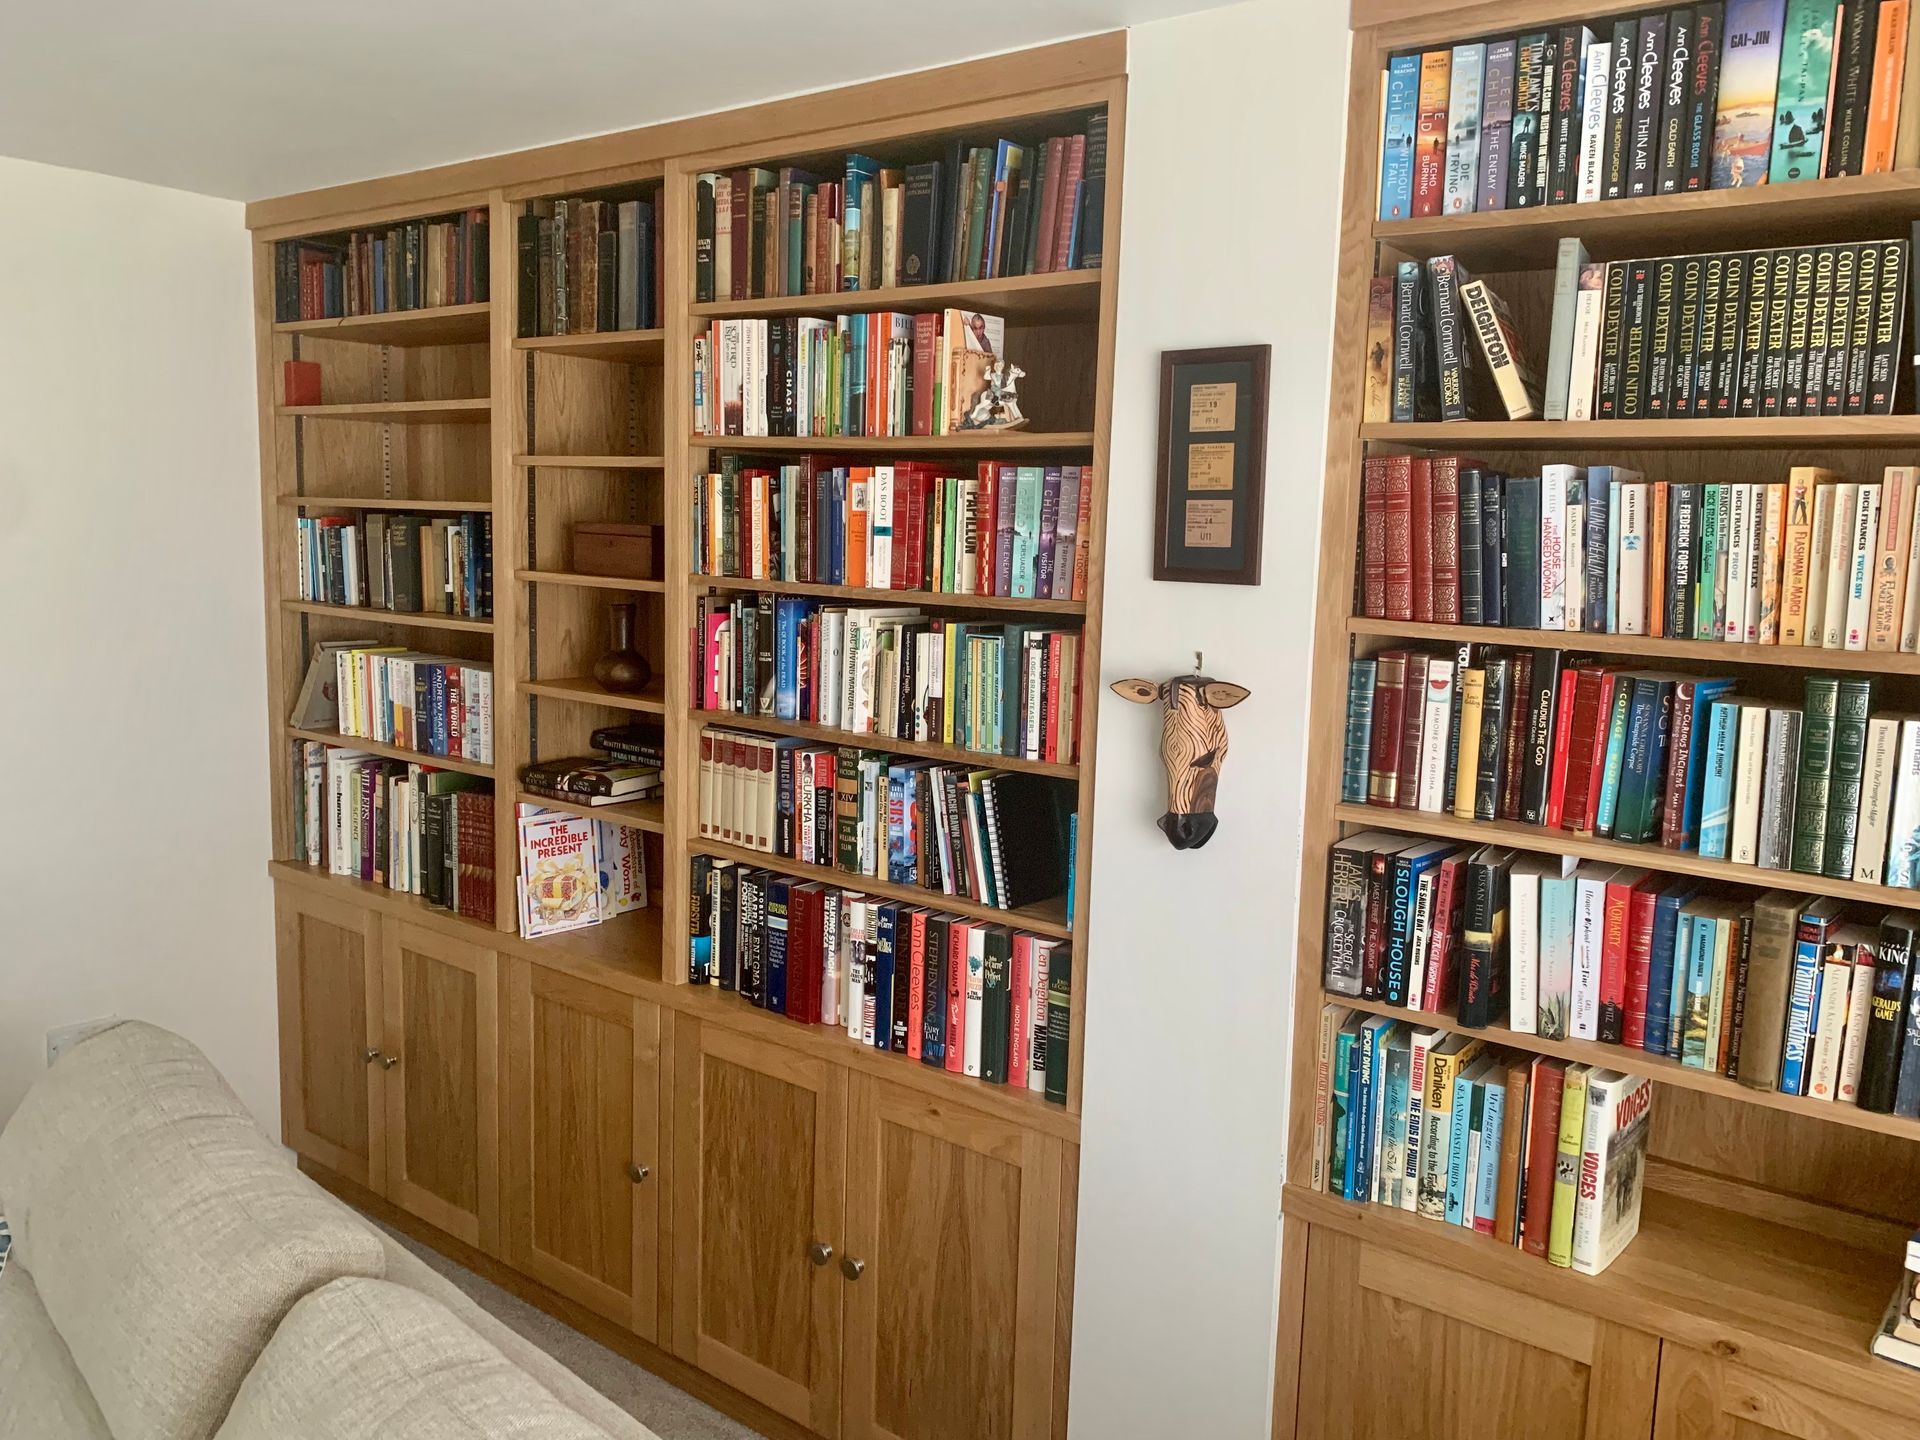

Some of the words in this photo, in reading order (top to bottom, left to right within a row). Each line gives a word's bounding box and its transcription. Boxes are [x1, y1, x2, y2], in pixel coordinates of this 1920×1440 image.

[1530, 41, 1544, 63] TOM
[1646, 32, 1656, 51] Ann
[1678, 27, 1688, 47] Ann
[1730, 30, 1770, 48] GAI-JIN
[1526, 64, 1542, 112] CLANCY'S
[1638, 51, 1658, 109] Cleeves
[1669, 48, 1689, 106] Cleeves
[1490, 130, 1499, 151] THE
[1637, 118, 1650, 148] THIN
[1669, 118, 1678, 140] COLD
[1635, 150, 1648, 170] AIR
[1666, 142, 1677, 167] EARTH
[1387, 163, 1399, 187] FAIL
[1396, 148, 1409, 201] WITHOUT
[1420, 155, 1429, 195] BURNING
[1429, 163, 1437, 187] ECHO
[1449, 153, 1460, 193] TRYING
[1460, 164, 1469, 181] DIE
[1488, 155, 1498, 189] ENEMY
[1518, 161, 1526, 187] MADEN
[1752, 257, 1768, 297] COLIN
[1796, 254, 1812, 294] COLIN
[1836, 252, 1853, 292] COLIN
[1859, 250, 1876, 291] COLIN
[1883, 247, 1900, 288] COLIN
[1400, 281, 1414, 326] Bernard
[1437, 273, 1450, 318] Bernard
[894, 317, 913, 329] BILL
[1466, 285, 1510, 369] DEIGHTON
[1746, 300, 1764, 351] DEXTER
[1790, 298, 1808, 350] DEXTER
[1831, 296, 1849, 348] DEXTER
[1853, 295, 1871, 346] DEXTER
[1877, 291, 1896, 344] DEXTER
[1400, 324, 1413, 371] Cornwell
[1440, 317, 1457, 366] Cornwell
[879, 494, 887, 522] BOOT
[1735, 490, 1743, 511] DICK
[1755, 493, 1763, 514] DICK
[1862, 490, 1871, 512] DICK
[964, 491, 977, 554] PAPILLON
[1543, 517, 1551, 557] HANGED
[1678, 504, 1692, 547] FREDERICK
[1732, 512, 1741, 548] FRANCIS
[1753, 515, 1762, 551] FRANCIS
[1858, 514, 1869, 551] FRANCIS
[1019, 540, 1027, 580] PERSUADER
[1059, 546, 1069, 581] TRIPWIRE
[1552, 537, 1561, 569] HOUSE
[1676, 550, 1690, 585] FORSYTH
[1731, 552, 1739, 581] PROOF
[1793, 532, 1808, 576] FLASHMAN
[1855, 554, 1865, 582] TWICE
[1543, 559, 1551, 599] WOMAN
[1750, 555, 1759, 588] REFLEX
[1677, 589, 1685, 601] THE
[1790, 586, 1802, 616] MARCH
[1854, 583, 1863, 600] SHY
[1675, 602, 1686, 634] DECEIVER
[848, 647, 857, 675] DIVING
[847, 676, 856, 711] MANUAL
[1028, 679, 1036, 734] BRAINTEASERS
[1539, 690, 1550, 728] CLAUDIUS
[1636, 704, 1645, 715] The
[481, 693, 490, 735] Sapiens
[1639, 704, 1651, 739] SUSANNA
[1537, 729, 1547, 745] THE
[1630, 716, 1642, 747] Cheapside
[1678, 714, 1691, 748] CURIOUS
[1535, 747, 1546, 765] GOD
[1628, 748, 1639, 769] Corpse
[1635, 740, 1647, 774] GREGORY
[1675, 749, 1688, 788] INCIDENT
[781, 759, 790, 789] VULCAN
[803, 775, 812, 823] GURKHA
[818, 789, 827, 812] STATE
[841, 793, 854, 801] XIV
[945, 783, 956, 810] APACHE
[550, 825, 568, 836] THE
[620, 826, 628, 848] wly
[818, 813, 827, 830] RED
[949, 810, 961, 838] DAWN
[530, 832, 589, 849] INCREDIBLE
[537, 843, 583, 859] PRESENT
[622, 854, 631, 896] Worm
[1332, 853, 1351, 908] HERBERT
[1350, 864, 1361, 901] JAMES
[1476, 868, 1486, 901] SUSAN
[1860, 869, 1874, 879] M
[690, 895, 700, 934] FORSYTH
[828, 896, 837, 934] TALKING
[1393, 869, 1407, 932] SLOUGH
[1474, 903, 1484, 929] HILL
[913, 917, 925, 948] Ann
[1331, 910, 1346, 956] CRICKLEY
[1431, 929, 1443, 960] PATRICIA
[752, 936, 760, 986] ENIGMA
[827, 935, 835, 977] STRAIGHT
[928, 931, 939, 988] STEPHEN
[1039, 946, 1049, 967] Len
[1331, 956, 1344, 980] HALL
[1389, 938, 1402, 990] HOUSE
[1879, 947, 1910, 964] KING
[911, 951, 924, 1010] Cleeves
[1428, 961, 1440, 994] HIGHSMITH
[1791, 965, 1818, 1006] family
[926, 990, 936, 1023] KING
[1036, 971, 1048, 1021] Deighton
[924, 1022, 939, 1034] FAIRY
[1875, 1008, 1894, 1021] GAME
[924, 1032, 938, 1042] TALE
[1032, 1024, 1047, 1072] MAMISTA
[1362, 1029, 1374, 1055] SPORT
[1785, 1009, 1811, 1062] madness
[1317, 1061, 1329, 1092] MILITARY
[1361, 1056, 1372, 1084] DIVING
[1411, 1046, 1425, 1091] HALDEMAN
[1432, 1057, 1448, 1109] Däniken
[1410, 1098, 1421, 1112] THE
[1457, 1084, 1465, 1100] SEA
[1616, 1079, 1652, 1131] VOICES
[1316, 1094, 1328, 1126] BLUNDERS
[1409, 1114, 1420, 1135] ENDS
[1455, 1101, 1464, 1121] AND
[1408, 1137, 1419, 1148] OF
[1453, 1122, 1463, 1161] COASTAL
[1406, 1148, 1417, 1178] POWER
[1451, 1163, 1461, 1187] BIRDS
